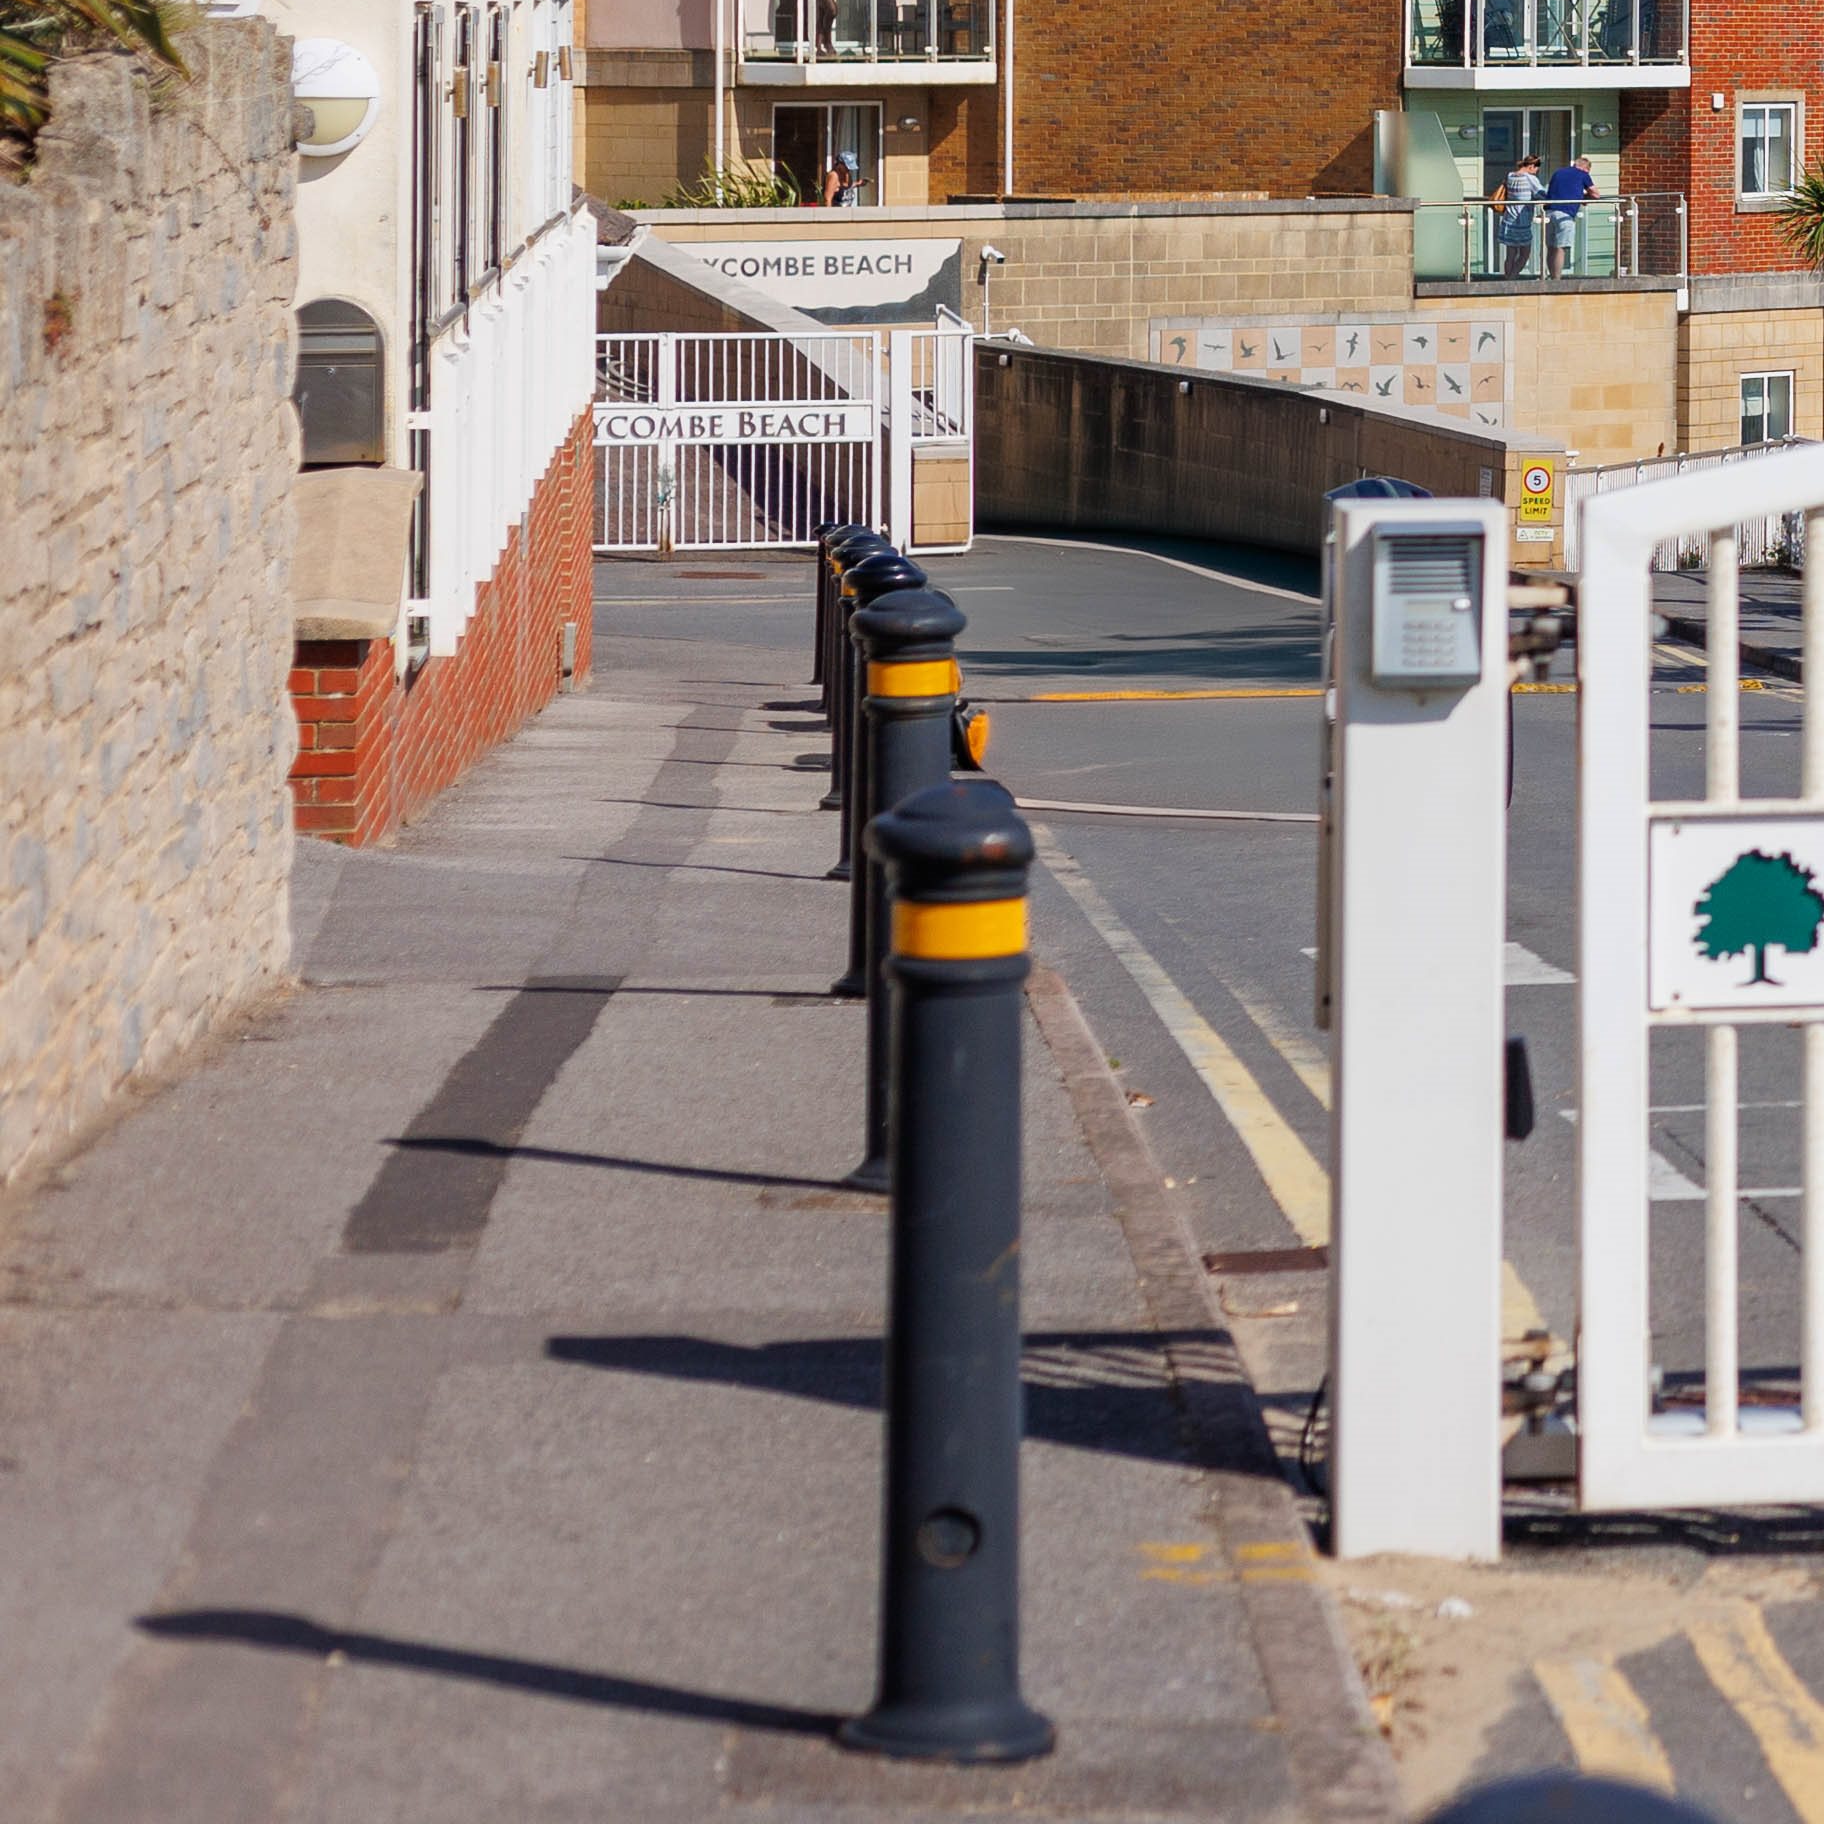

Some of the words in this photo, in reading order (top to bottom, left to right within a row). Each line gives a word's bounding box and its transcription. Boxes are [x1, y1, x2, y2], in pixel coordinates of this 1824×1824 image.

[824, 254, 912, 275] BEACH
[738, 412, 846, 438] BEACH
[1533, 475, 1541, 486] 5
[1523, 497, 1550, 505] SPEED
[1525, 507, 1547, 515] LIMIT
